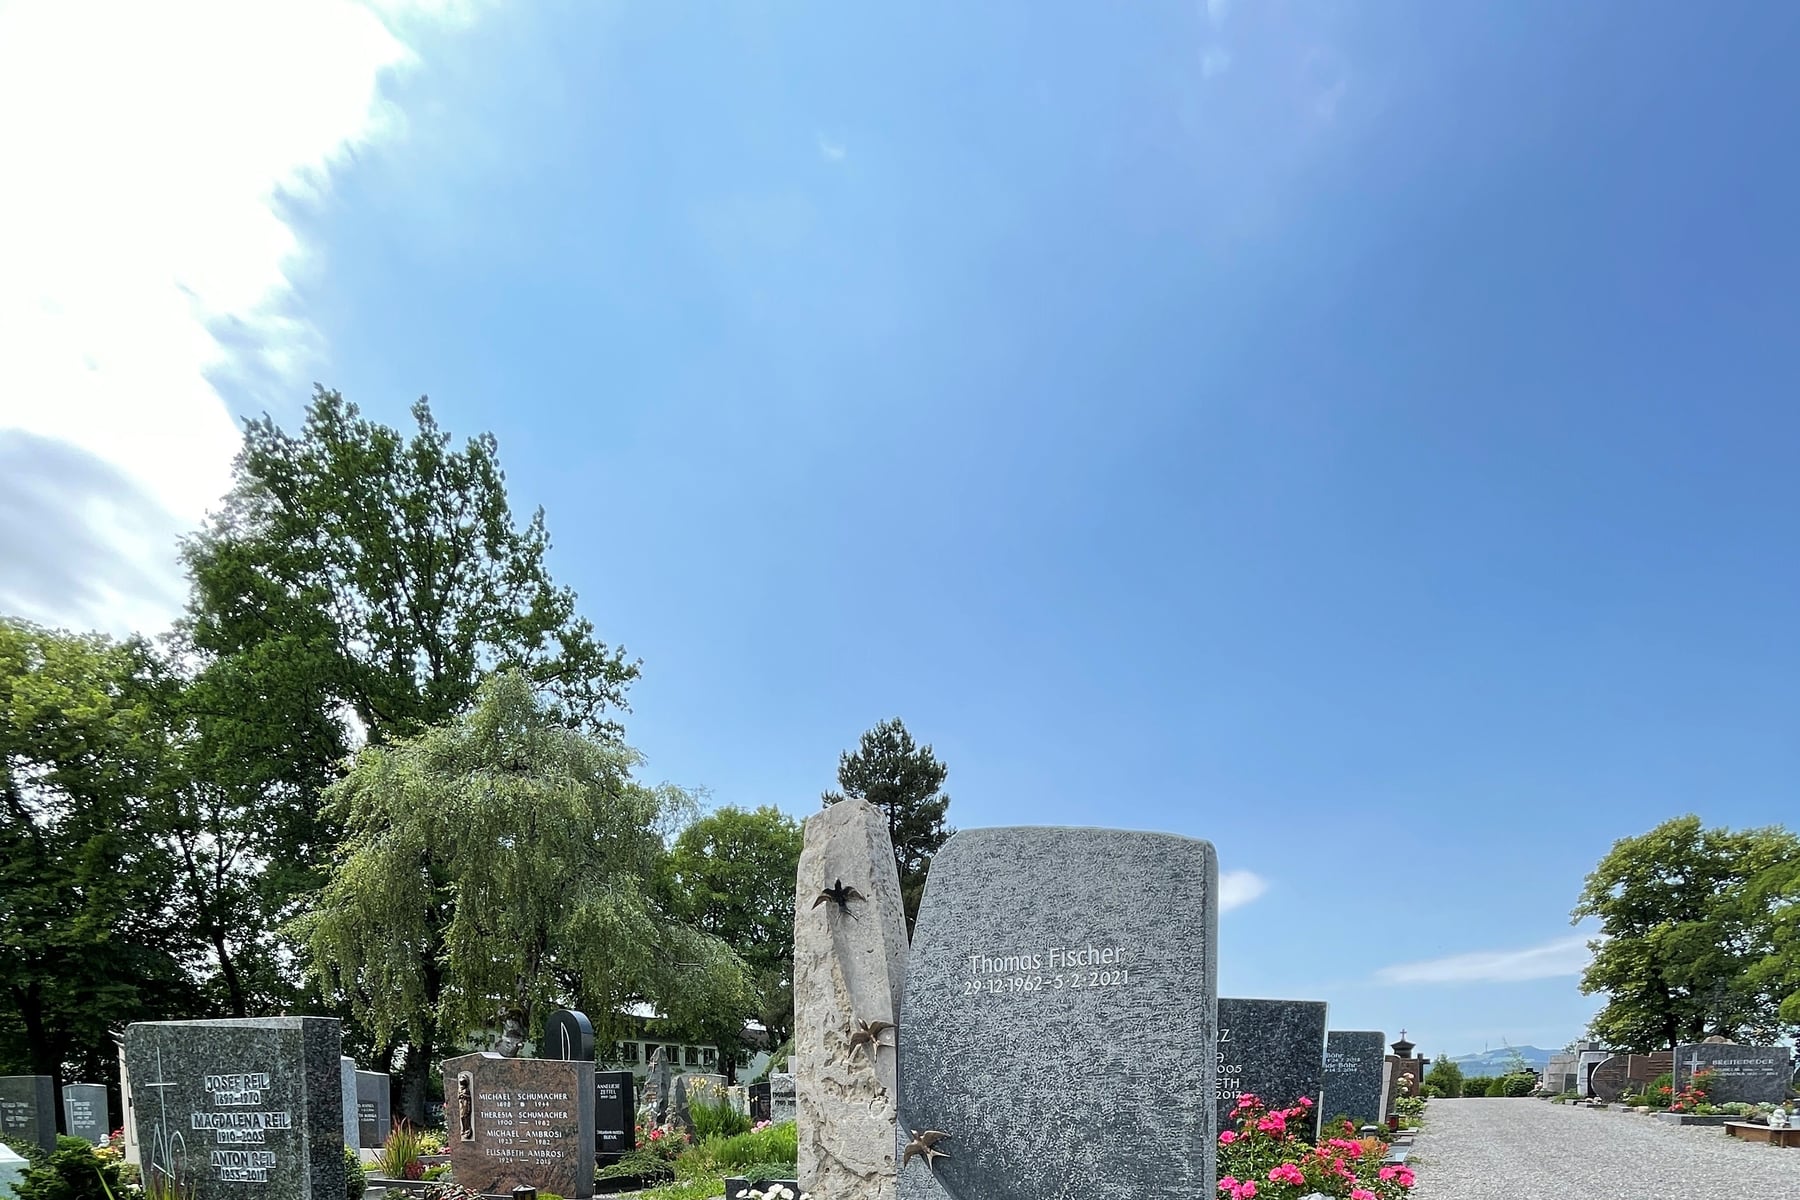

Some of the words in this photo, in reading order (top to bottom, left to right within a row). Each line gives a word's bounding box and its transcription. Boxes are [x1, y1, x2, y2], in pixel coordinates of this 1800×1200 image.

[968, 954, 1042, 974] Thomas
[1049, 943, 1126, 968] Fischer
[1216, 1064, 1242, 1073] 005
[206, 1075, 241, 1091] JOSEF
[243, 1074, 268, 1089] REIL
[193, 1113, 261, 1128] MAGDALENA
[263, 1112, 290, 1128] REIL
[480, 1111, 513, 1119] THERESIA
[518, 1111, 569, 1119] SCHUMACHER
[525, 1130, 562, 1138] AMBROSI
[212, 1151, 249, 1166] ANTON
[251, 1151, 276, 1167] REIL
